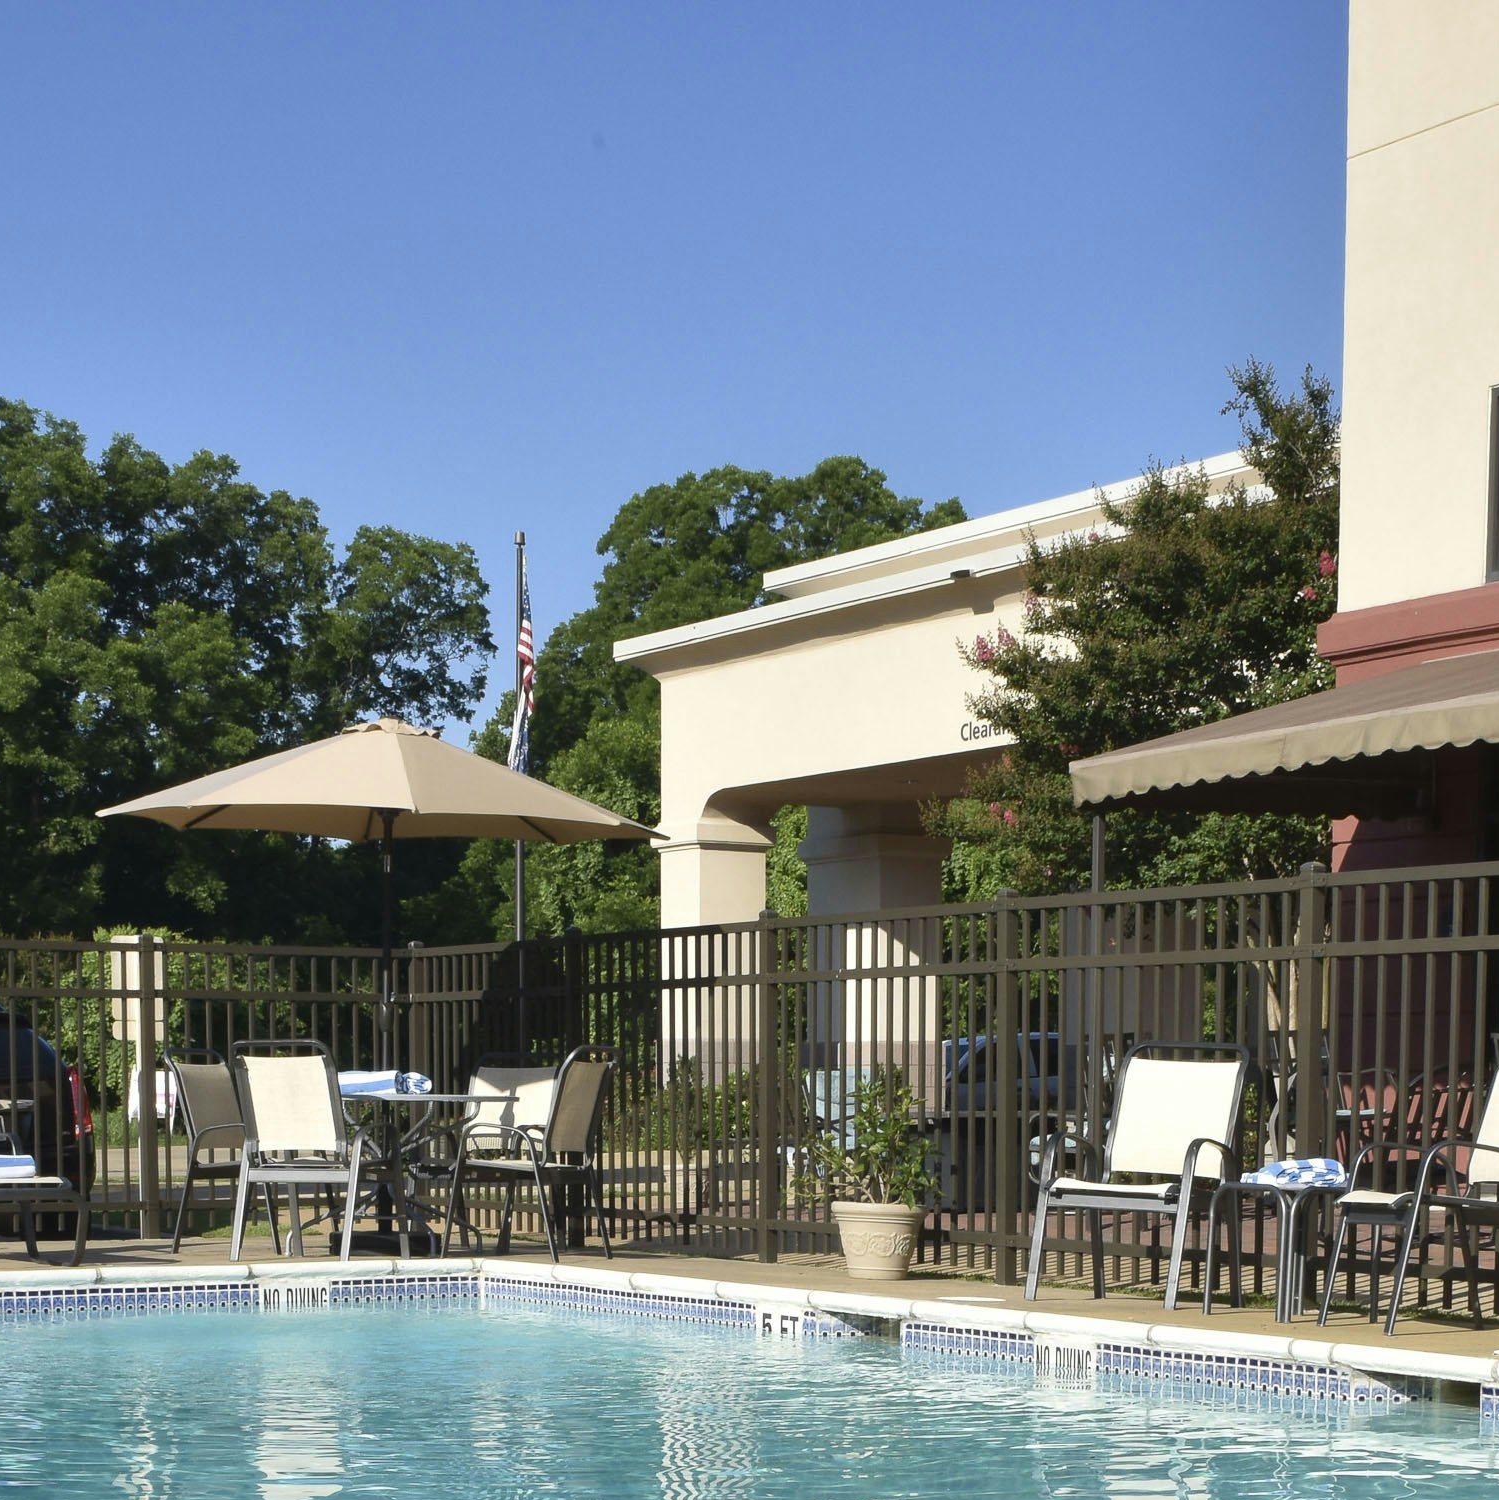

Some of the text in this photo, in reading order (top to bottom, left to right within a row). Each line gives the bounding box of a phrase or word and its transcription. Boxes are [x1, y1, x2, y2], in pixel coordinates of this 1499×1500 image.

[263, 1287, 327, 1309] NO DIVING
[762, 1313, 799, 1336] 5 FT
[1035, 1344, 1050, 1372] NO
